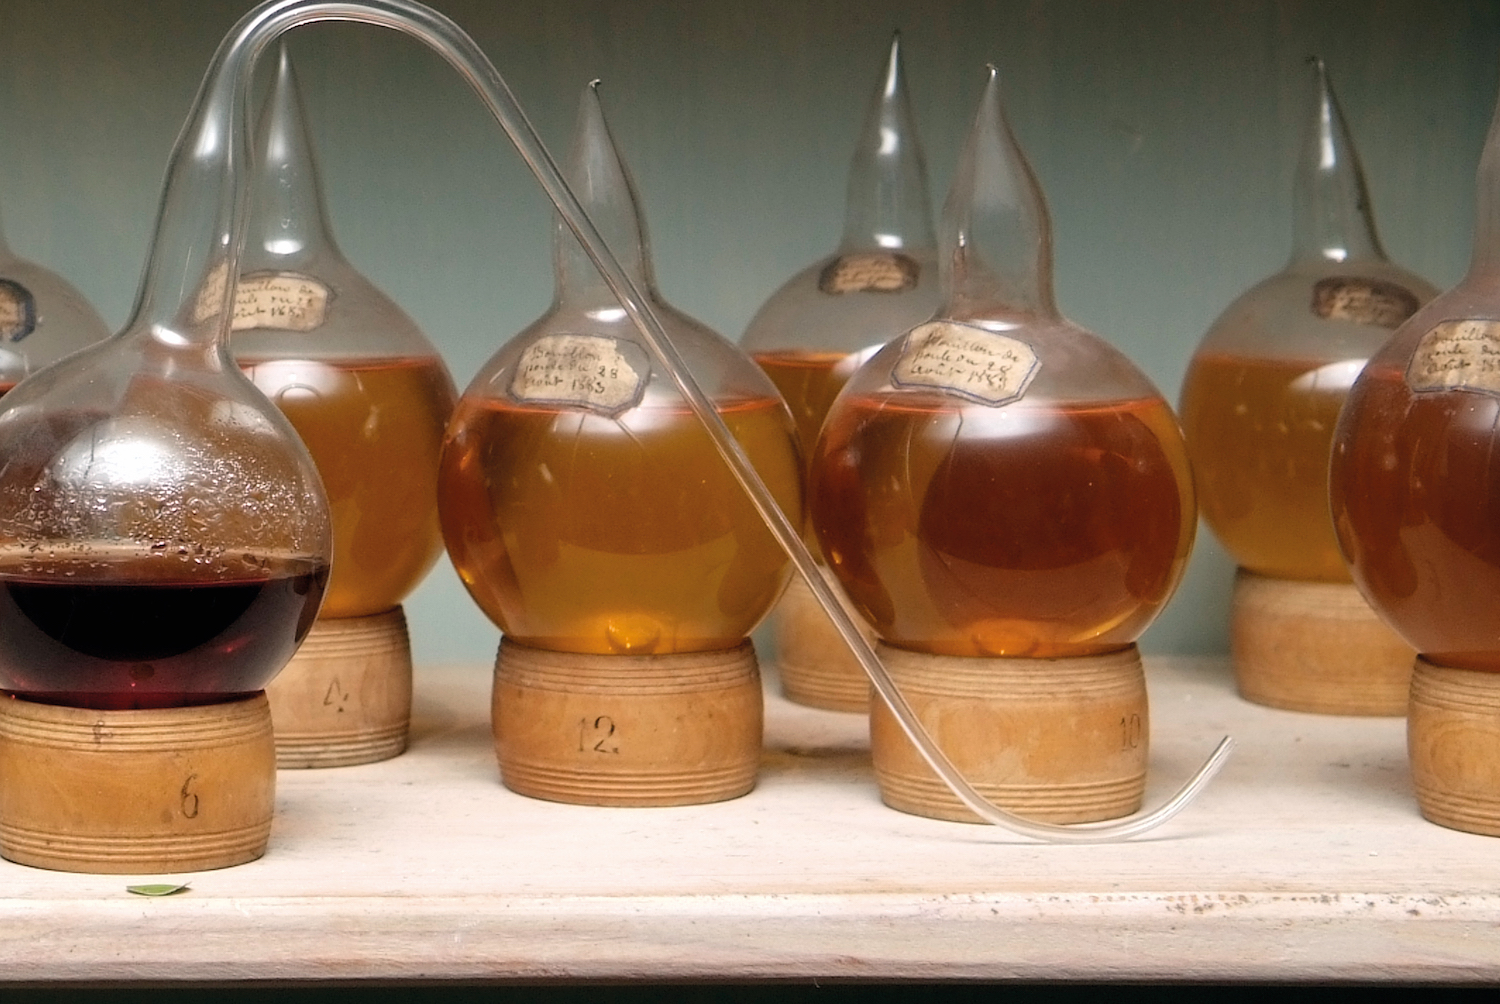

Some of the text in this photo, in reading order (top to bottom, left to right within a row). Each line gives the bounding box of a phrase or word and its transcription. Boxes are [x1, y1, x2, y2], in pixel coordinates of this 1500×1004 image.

[912, 349, 951, 365] poule
[955, 353, 980, 366] du
[1002, 349, 1020, 363] de
[523, 360, 564, 378] poule
[597, 365, 619, 379] 28
[910, 362, 965, 377] août
[577, 715, 619, 754] 12
[1119, 713, 1142, 752] 10
[180, 773, 200, 820] 6
